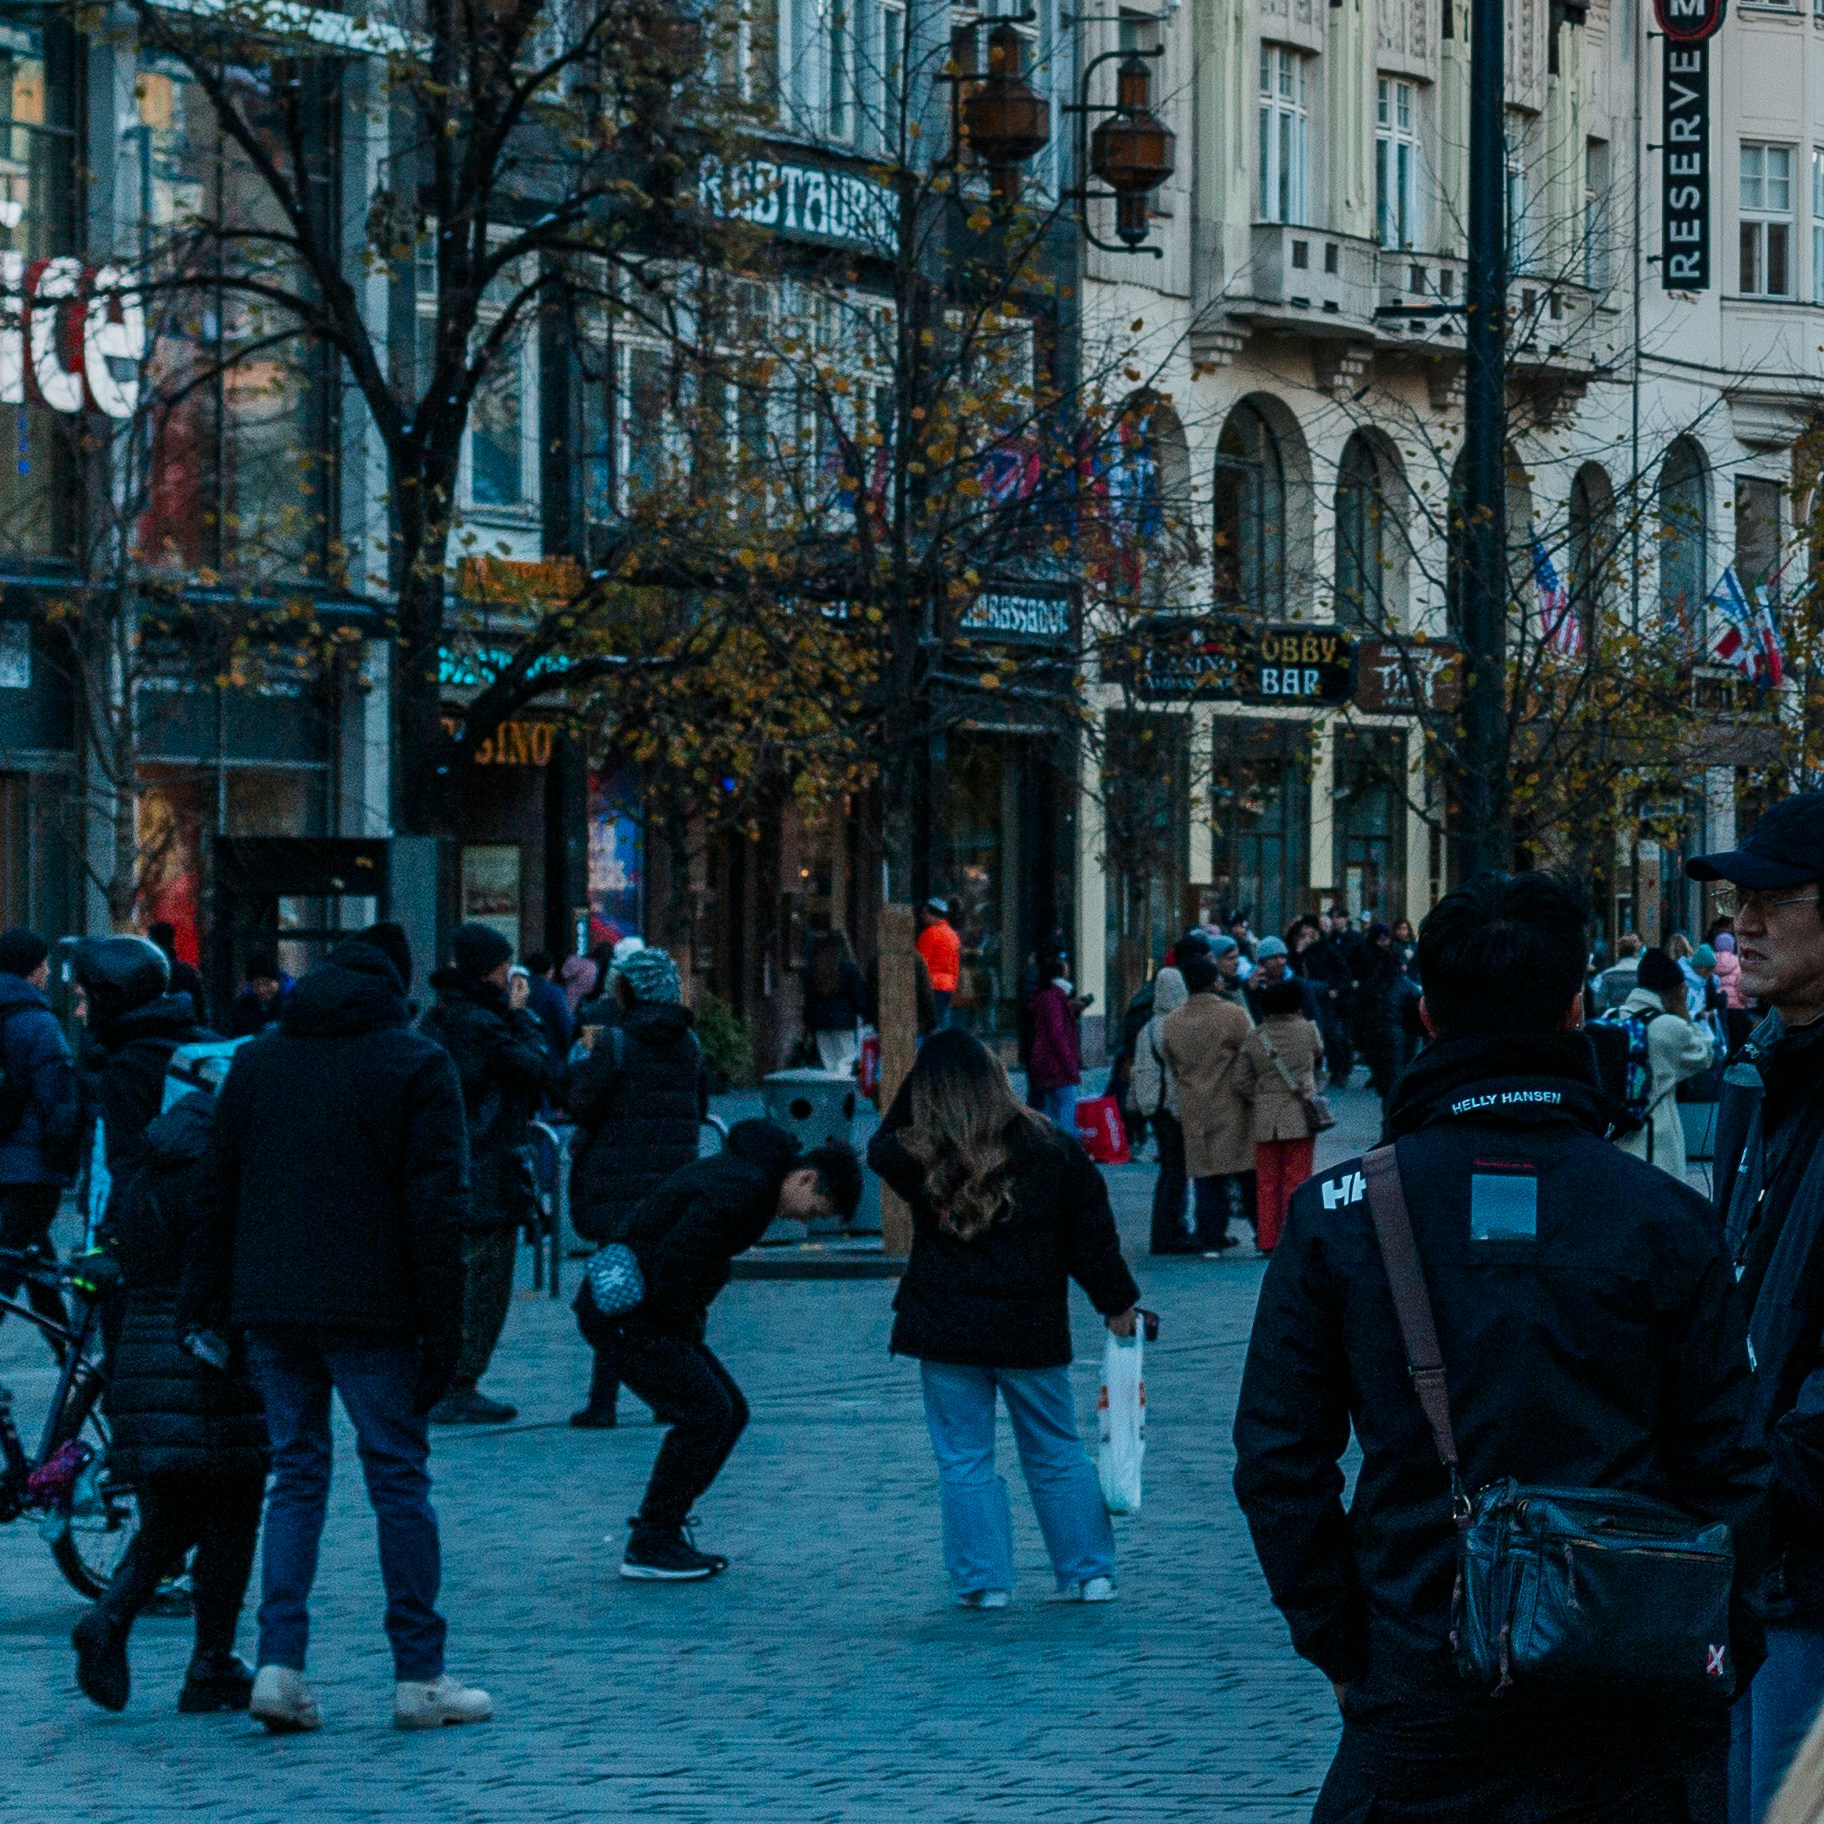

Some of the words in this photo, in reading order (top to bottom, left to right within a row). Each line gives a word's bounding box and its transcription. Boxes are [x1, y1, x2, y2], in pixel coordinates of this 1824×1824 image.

[1668, 49, 1702, 278] RESERVE
[1260, 636, 1337, 663] OBBY
[1261, 668, 1320, 695] BAR
[1451, 1093, 1498, 1116] HELLY
[1501, 1090, 1562, 1105] HANSEN
